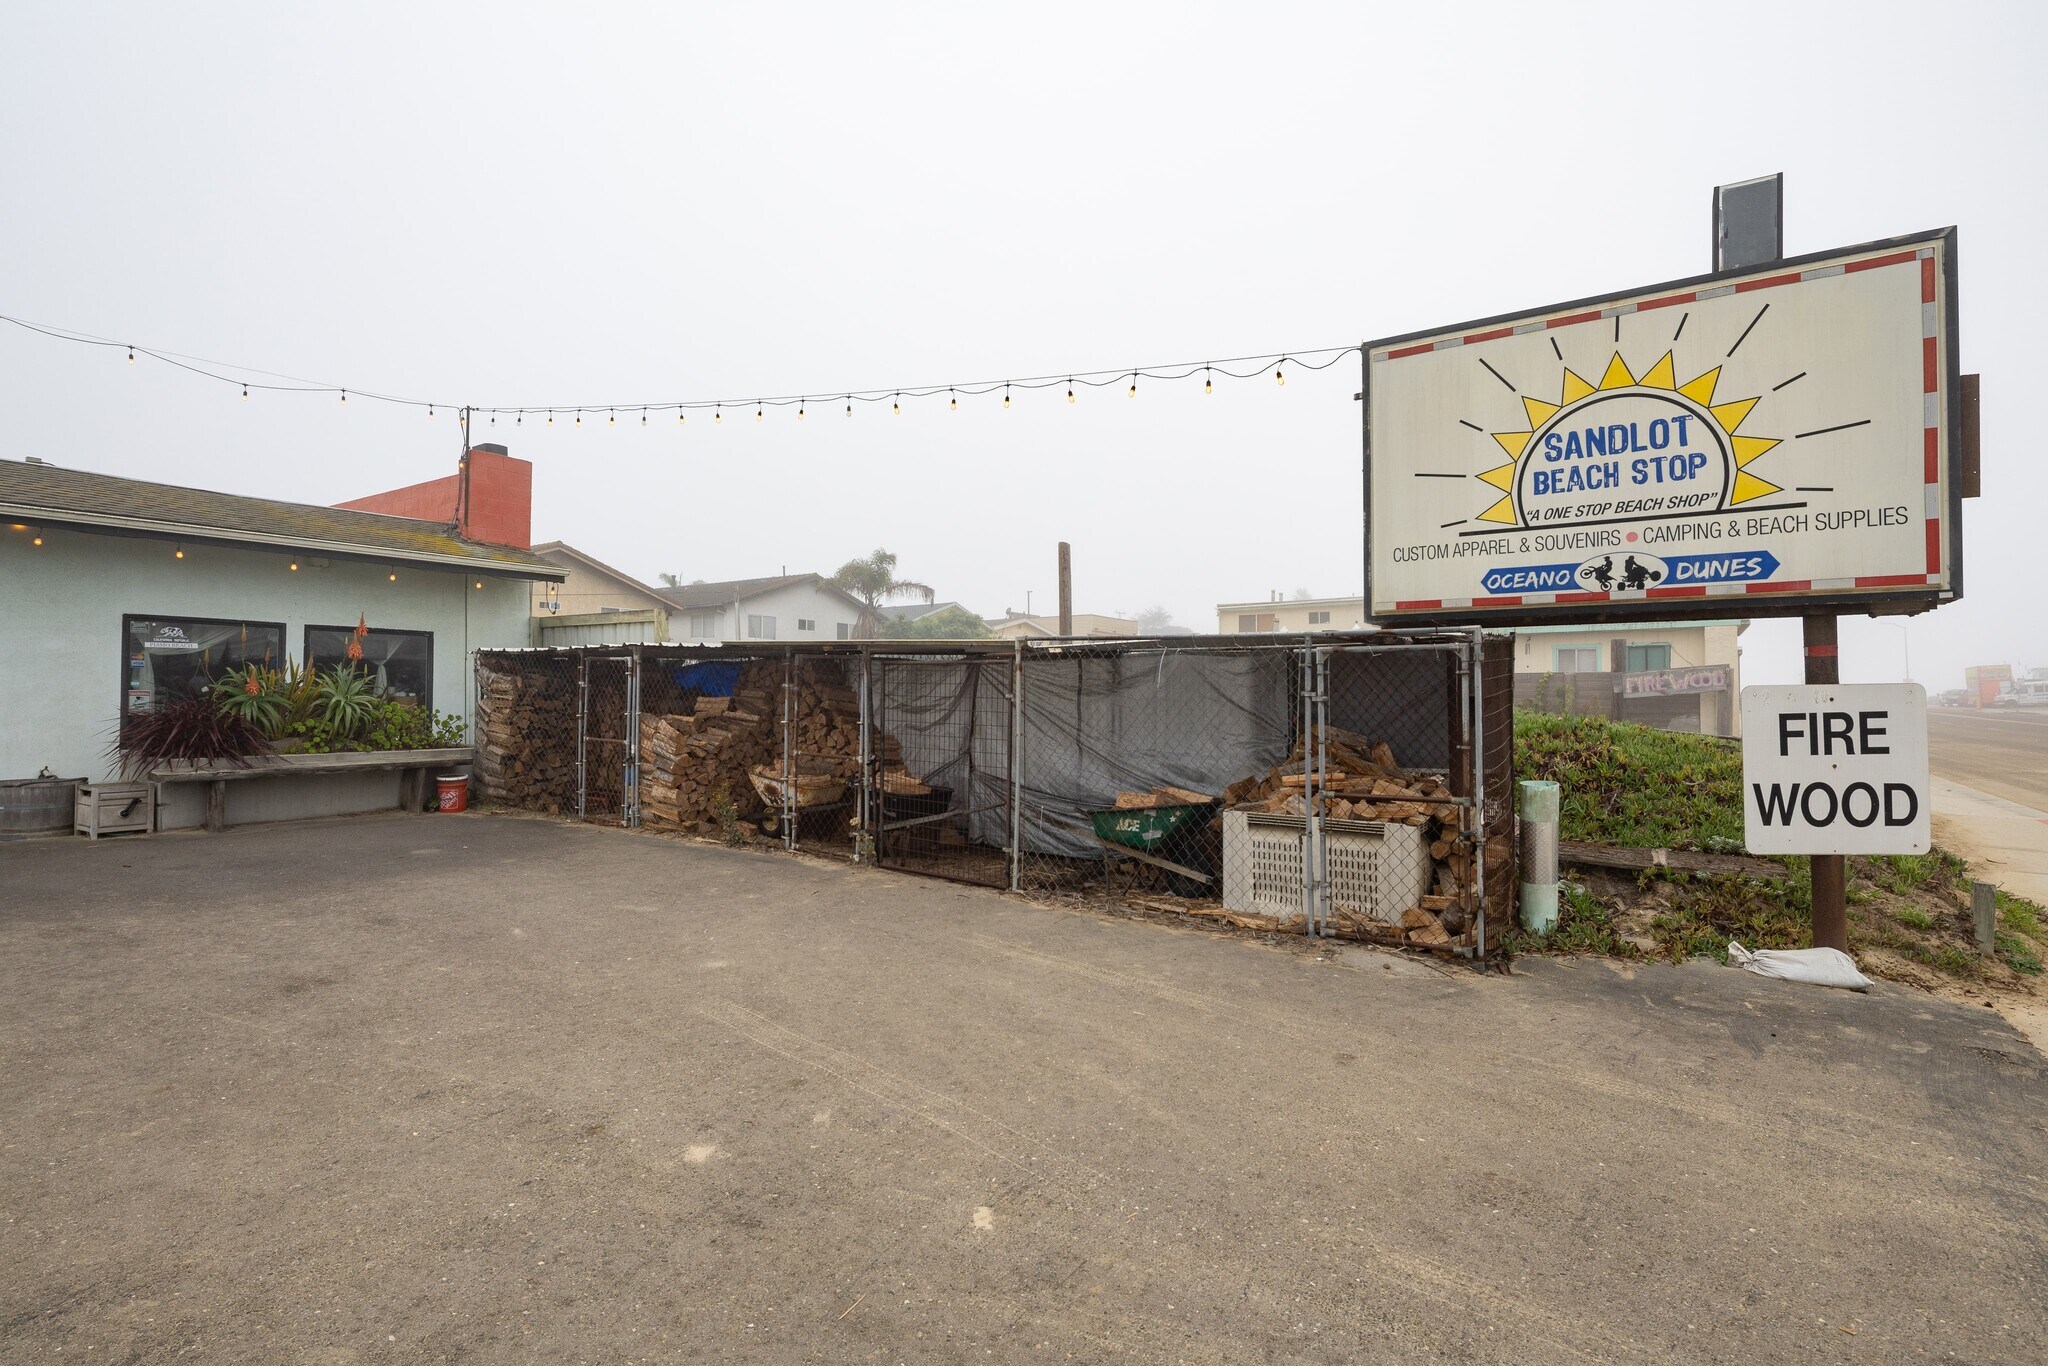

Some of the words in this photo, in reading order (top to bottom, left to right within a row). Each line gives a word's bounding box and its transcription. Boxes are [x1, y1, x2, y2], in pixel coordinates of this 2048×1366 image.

[1544, 414, 1694, 462] SANDLOT
[1533, 461, 1619, 495] BEACH
[1631, 452, 1707, 485] STOP
[1544, 506, 1573, 521] ONE
[1575, 502, 1613, 517] STOP
[1614, 498, 1664, 514] BEACH
[1643, 521, 1722, 544] CAMPING
[1728, 520, 1741, 538] &
[1747, 514, 1808, 537] BEACH
[1815, 506, 1908, 531] SUPPLIES
[1393, 544, 1449, 562] CUSTOM
[1452, 539, 1515, 558] APPAREL
[1519, 537, 1531, 553] &
[1535, 529, 1621, 552] SOUVENIRS
[1487, 569, 1570, 590] OCEANO
[1676, 557, 1762, 580] DUNES
[1779, 711, 1890, 756] FIRE
[1752, 781, 1919, 828] WOOD
[1116, 818, 1140, 832] ACE
